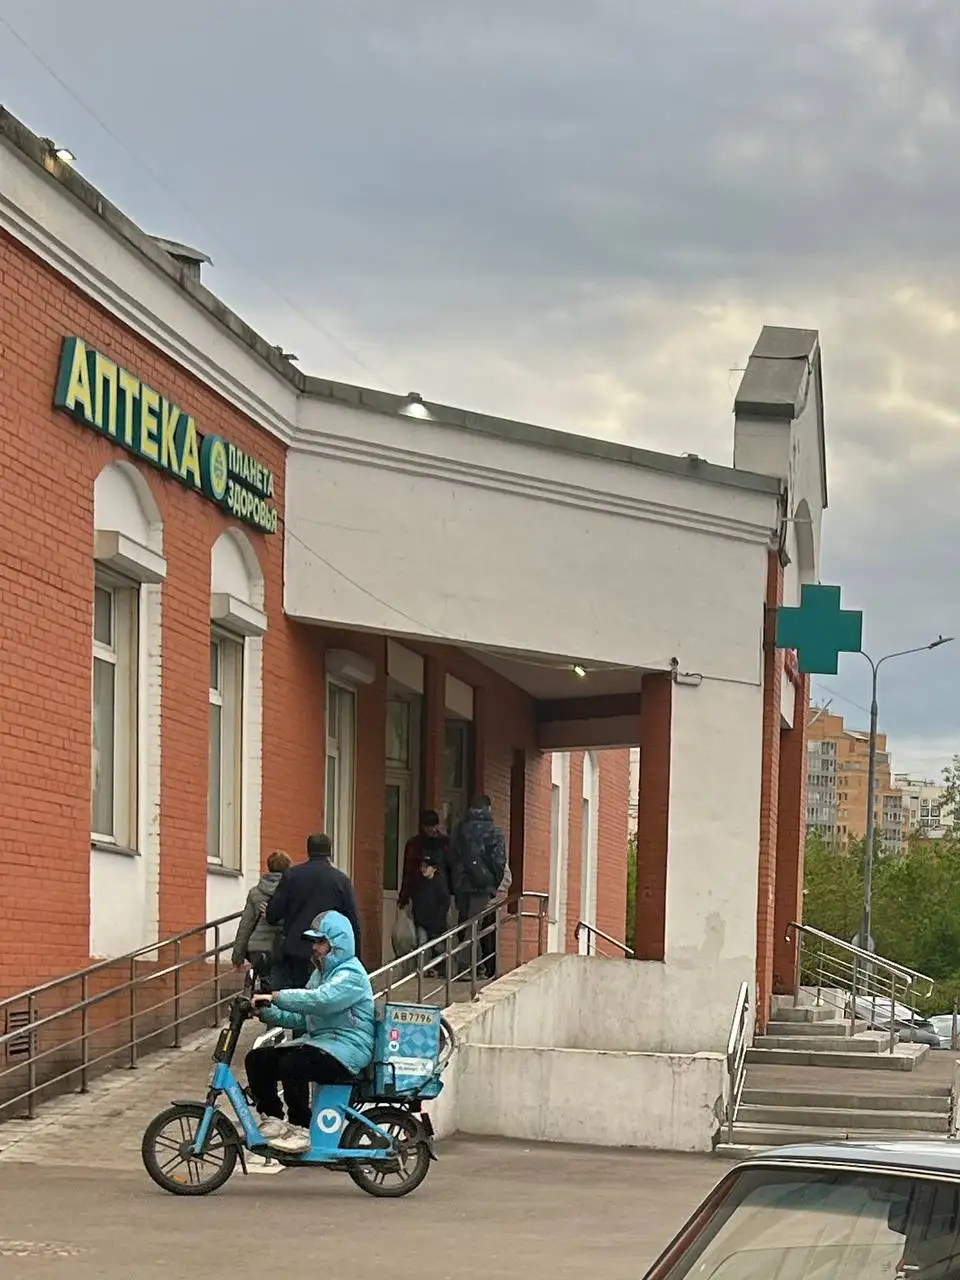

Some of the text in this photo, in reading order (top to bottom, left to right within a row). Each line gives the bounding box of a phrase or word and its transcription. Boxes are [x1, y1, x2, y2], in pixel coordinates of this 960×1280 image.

[64, 337, 201, 488] АПТЕКА
[228, 443, 276, 499] ПЛАНЕТА
[227, 479, 277, 533] ЗДОРОВЬЯ
